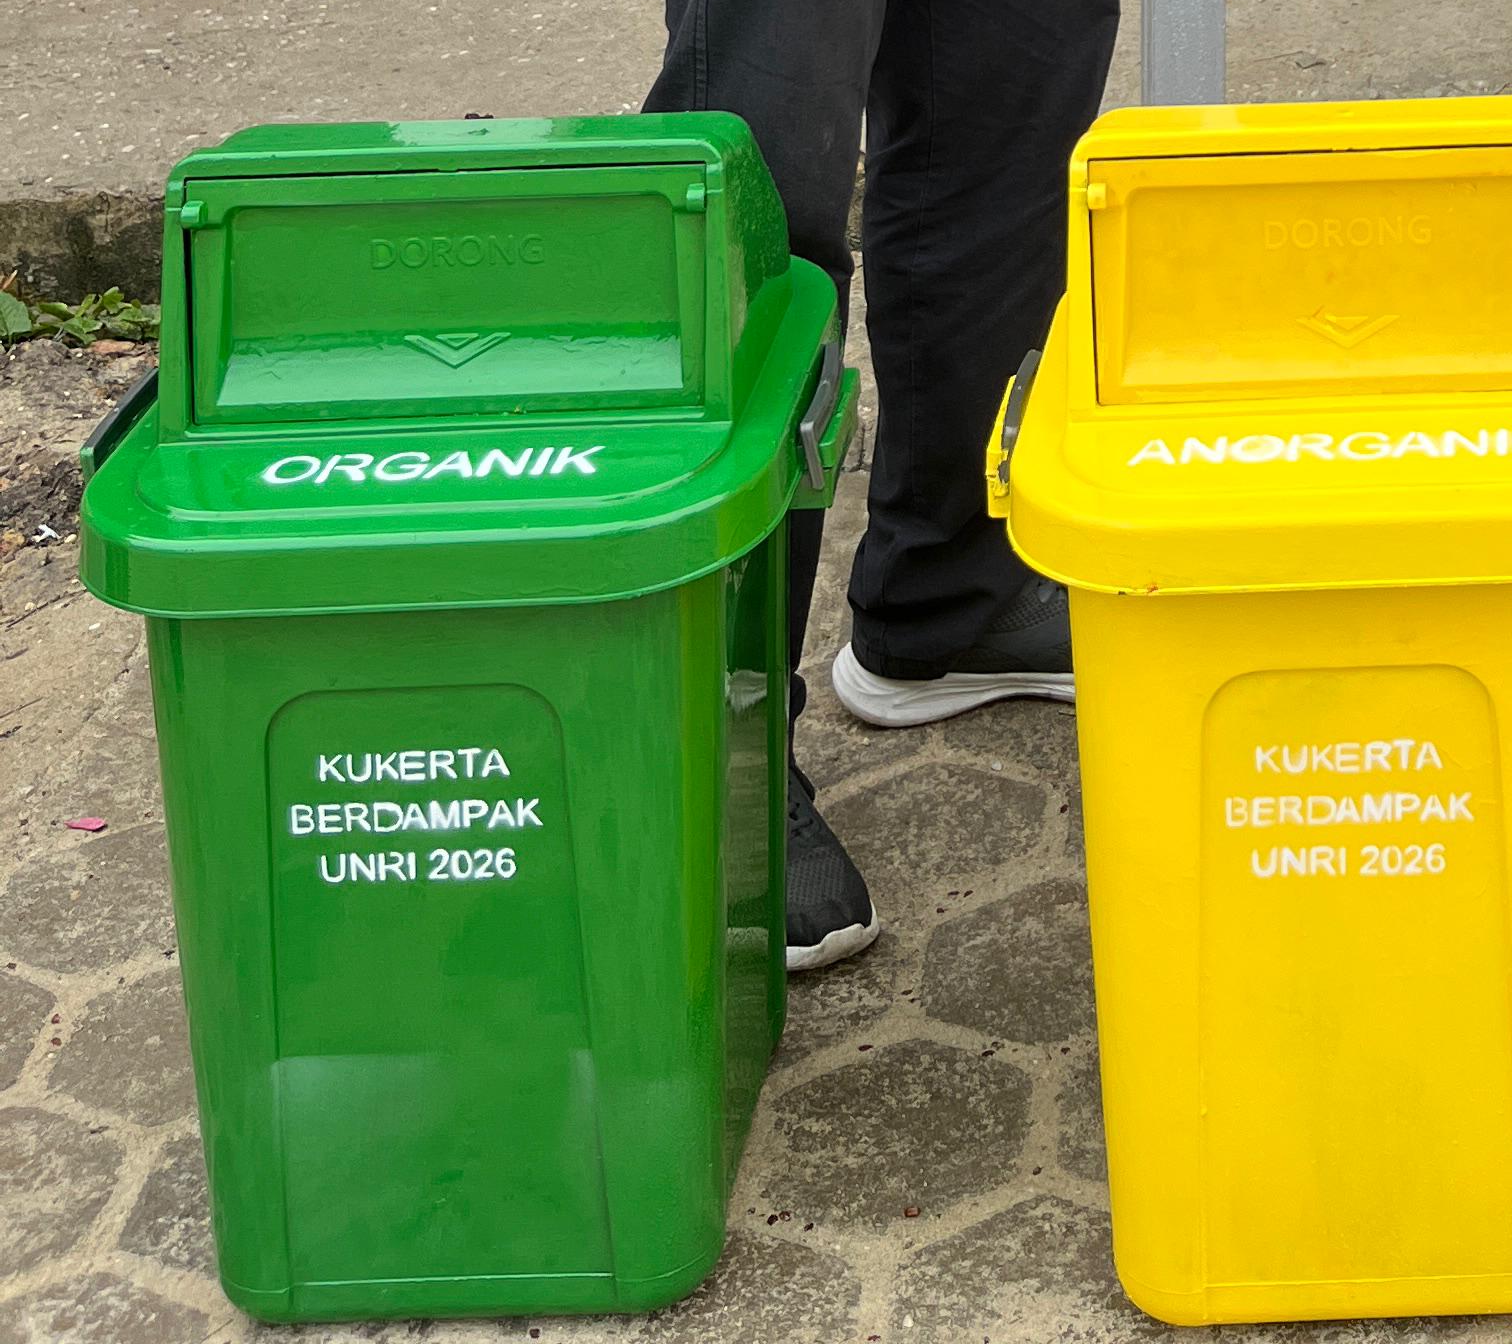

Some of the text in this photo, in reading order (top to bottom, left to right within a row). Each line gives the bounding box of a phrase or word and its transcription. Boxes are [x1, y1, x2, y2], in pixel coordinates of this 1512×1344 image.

[1265, 214, 1432, 251] DORONG
[370, 234, 545, 270] DORONG
[261, 445, 605, 485] ORGANIK
[318, 747, 511, 783] KUKERTA
[1254, 738, 1444, 775] KUKERTA
[290, 797, 544, 835] BERDAMPAK
[1224, 791, 1474, 829] BERDAMPAK
[320, 847, 517, 883] UNRI 2026
[1250, 843, 1446, 879] UNRI 2026
